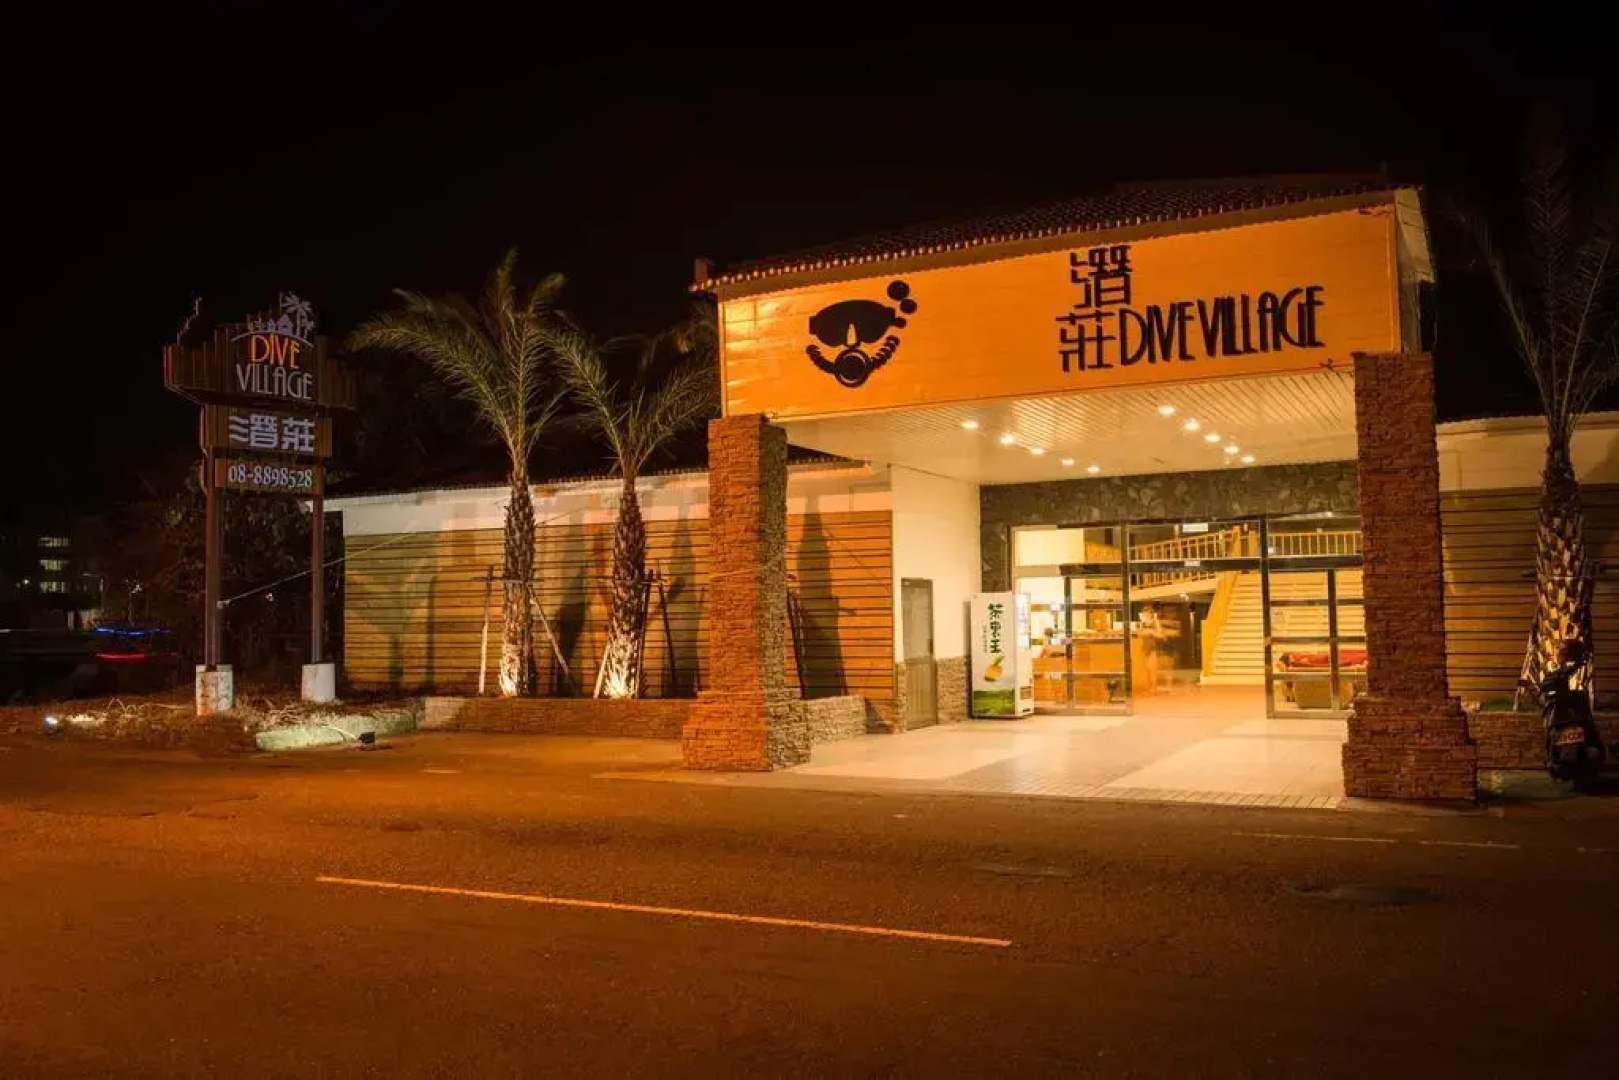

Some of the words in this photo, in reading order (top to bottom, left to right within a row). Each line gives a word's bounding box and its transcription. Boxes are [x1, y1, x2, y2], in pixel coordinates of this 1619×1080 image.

[1119, 301, 1196, 366] DIVE
[1197, 286, 1326, 357] VILLAGE
[251, 334, 300, 369] DIVE
[236, 363, 313, 400] VILLAGE
[228, 464, 312, 488] 08-8898528
